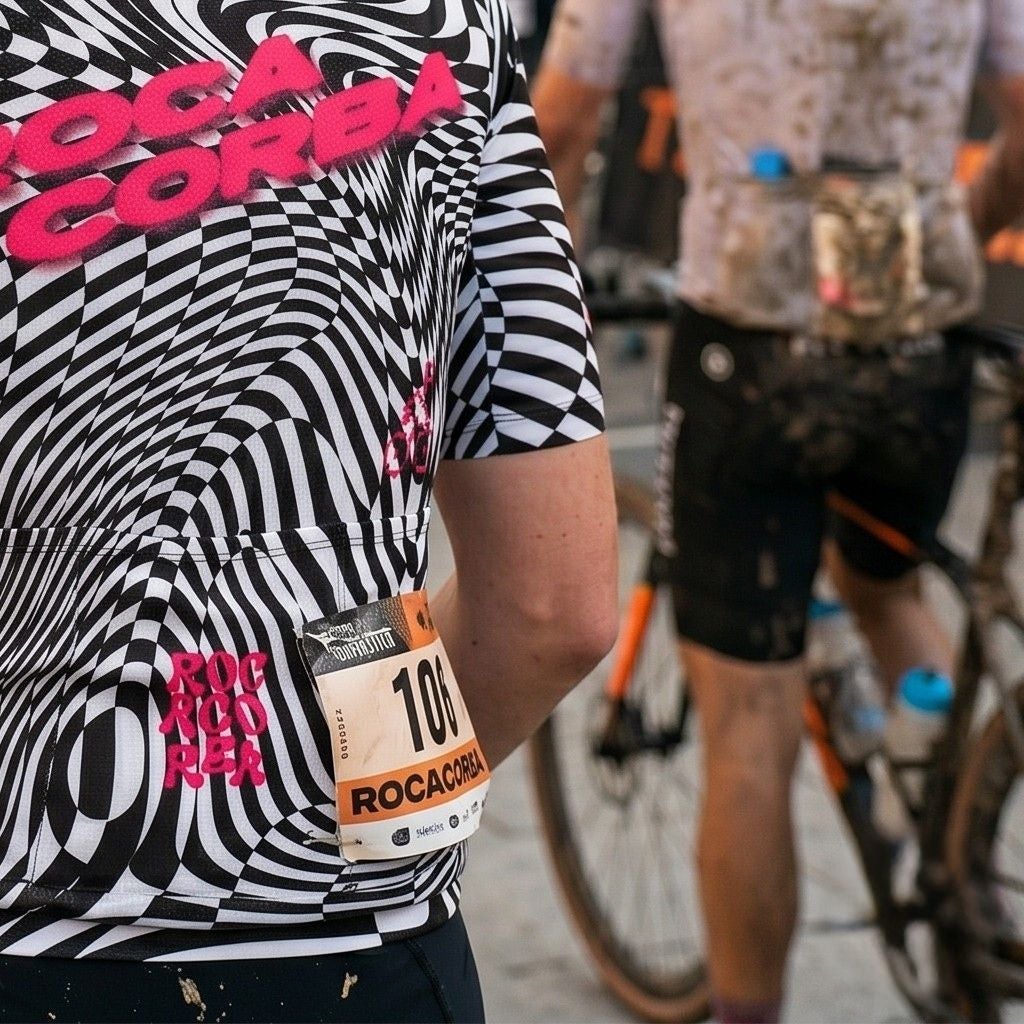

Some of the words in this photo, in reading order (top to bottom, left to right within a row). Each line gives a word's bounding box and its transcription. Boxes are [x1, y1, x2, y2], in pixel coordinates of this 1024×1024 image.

[6, 51, 463, 264] CORBA
[166, 650, 267, 696] ROC
[159, 692, 267, 741] RCO
[351, 749, 484, 815] ROCACORBA
